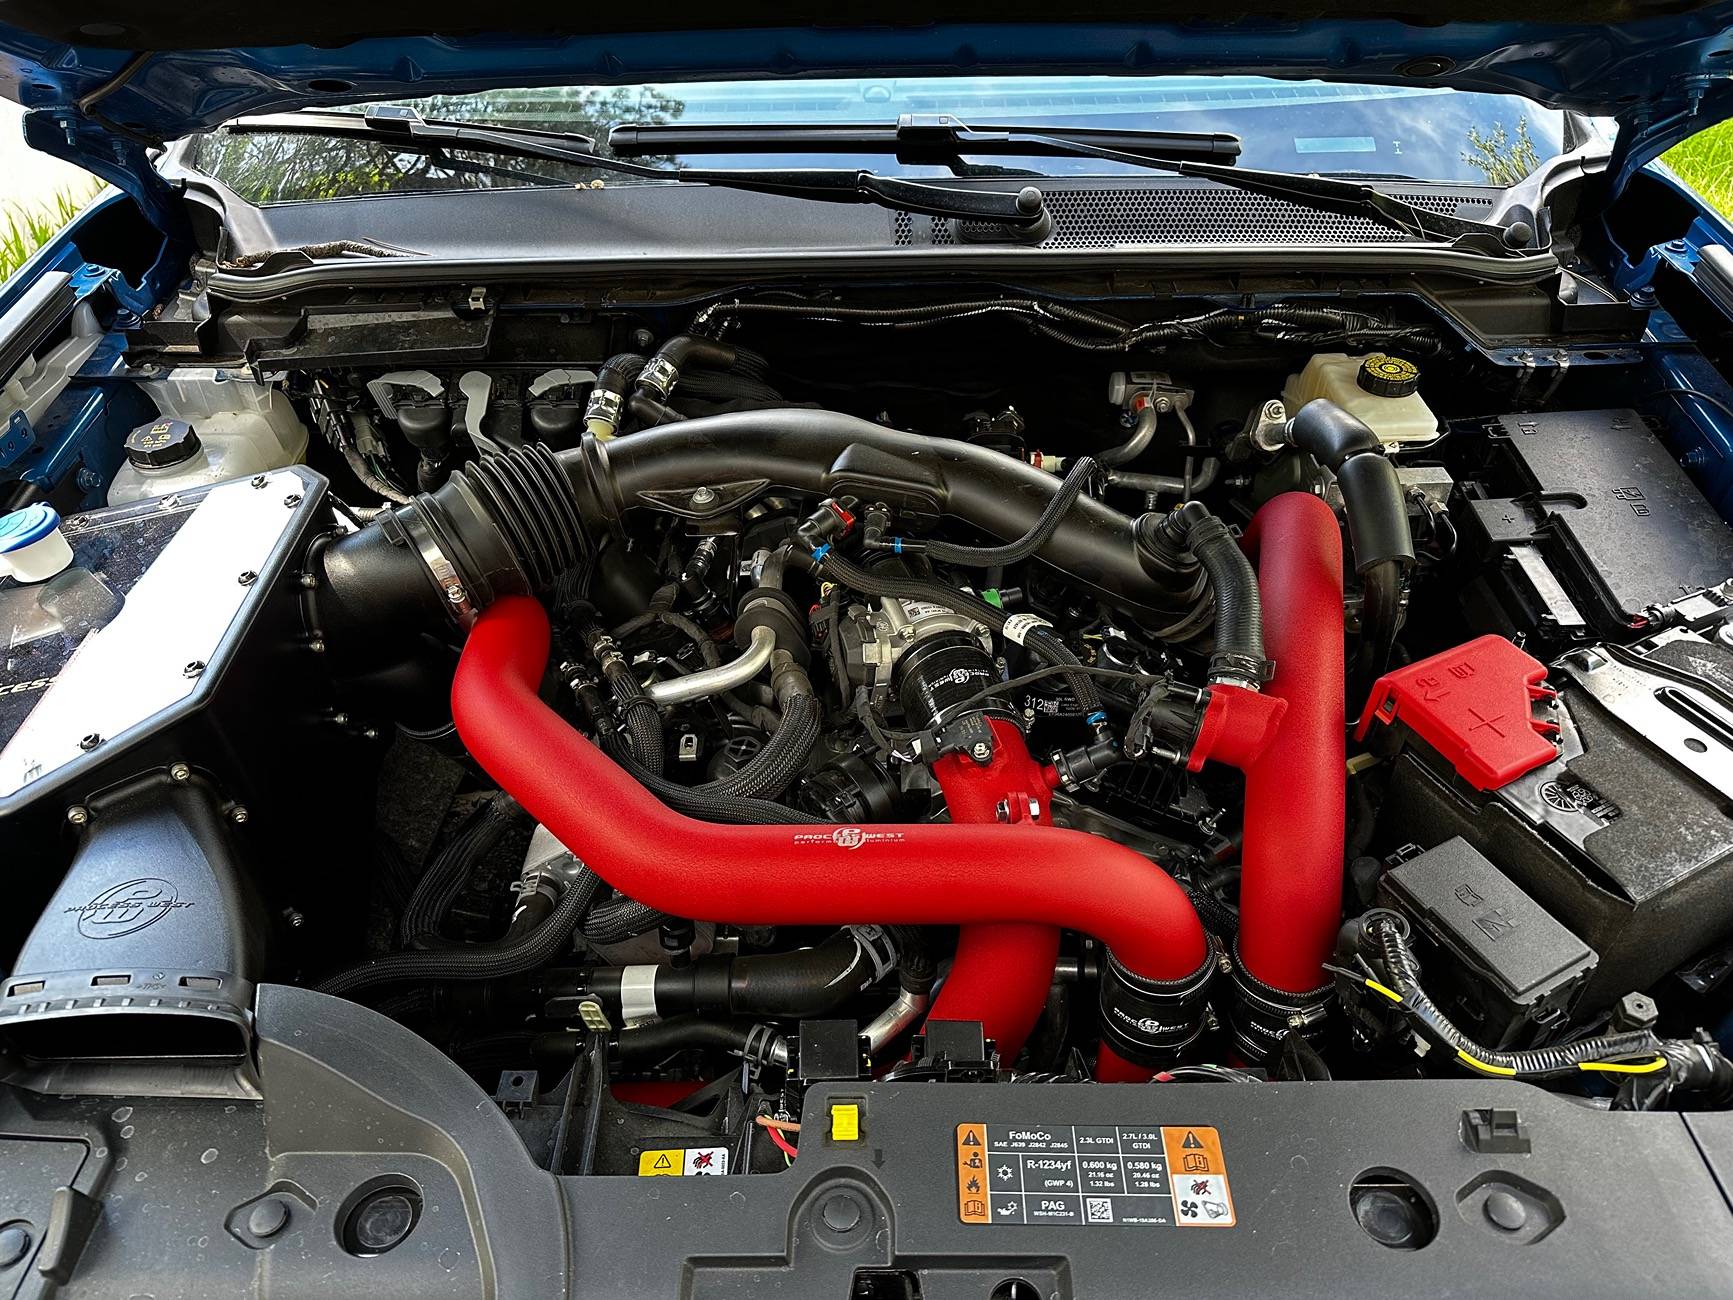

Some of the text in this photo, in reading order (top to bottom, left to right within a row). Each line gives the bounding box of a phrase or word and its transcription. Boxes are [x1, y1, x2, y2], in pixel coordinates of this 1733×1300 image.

[1024, 694, 1044, 711] 312
[147, 899, 196, 909] WEST
[1009, 1131, 1052, 1140] FoMoCo
[1026, 1159, 1072, 1172] R-1234yf
[1082, 1161, 1118, 1171] 0.600 kg
[1127, 1161, 1163, 1171] 0.580 kg
[1044, 1180, 1065, 1188] (GWP
[1041, 1200, 1066, 1211] PAG
